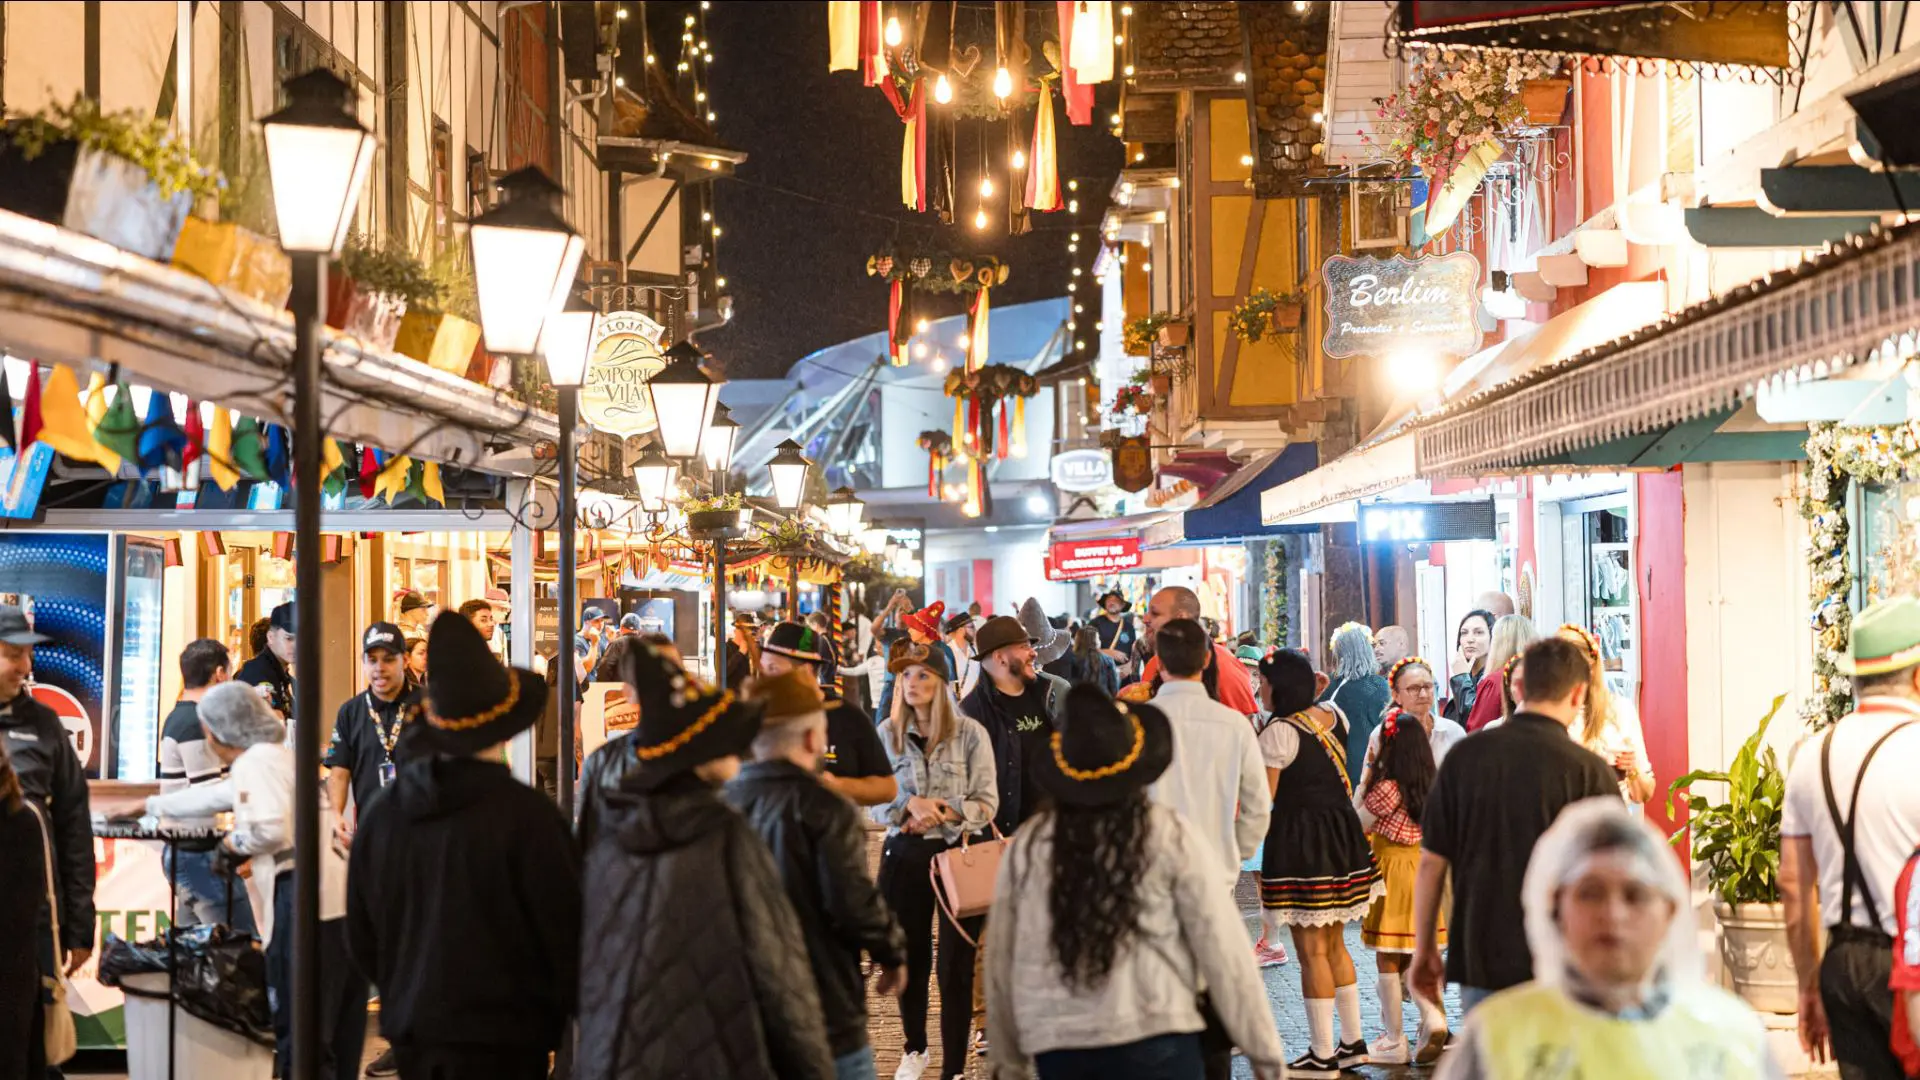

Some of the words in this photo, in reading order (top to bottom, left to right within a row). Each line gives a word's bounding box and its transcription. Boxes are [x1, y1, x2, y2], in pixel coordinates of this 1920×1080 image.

[1350, 274, 1449, 307] Berlim
[606, 321, 643, 333] LOJA
[1340, 321, 1392, 336] Presentes
[605, 384, 641, 403] VILA
[1064, 460, 1106, 477] VILLA
[1366, 509, 1425, 540] PIX
[1105, 557, 1114, 567] &
